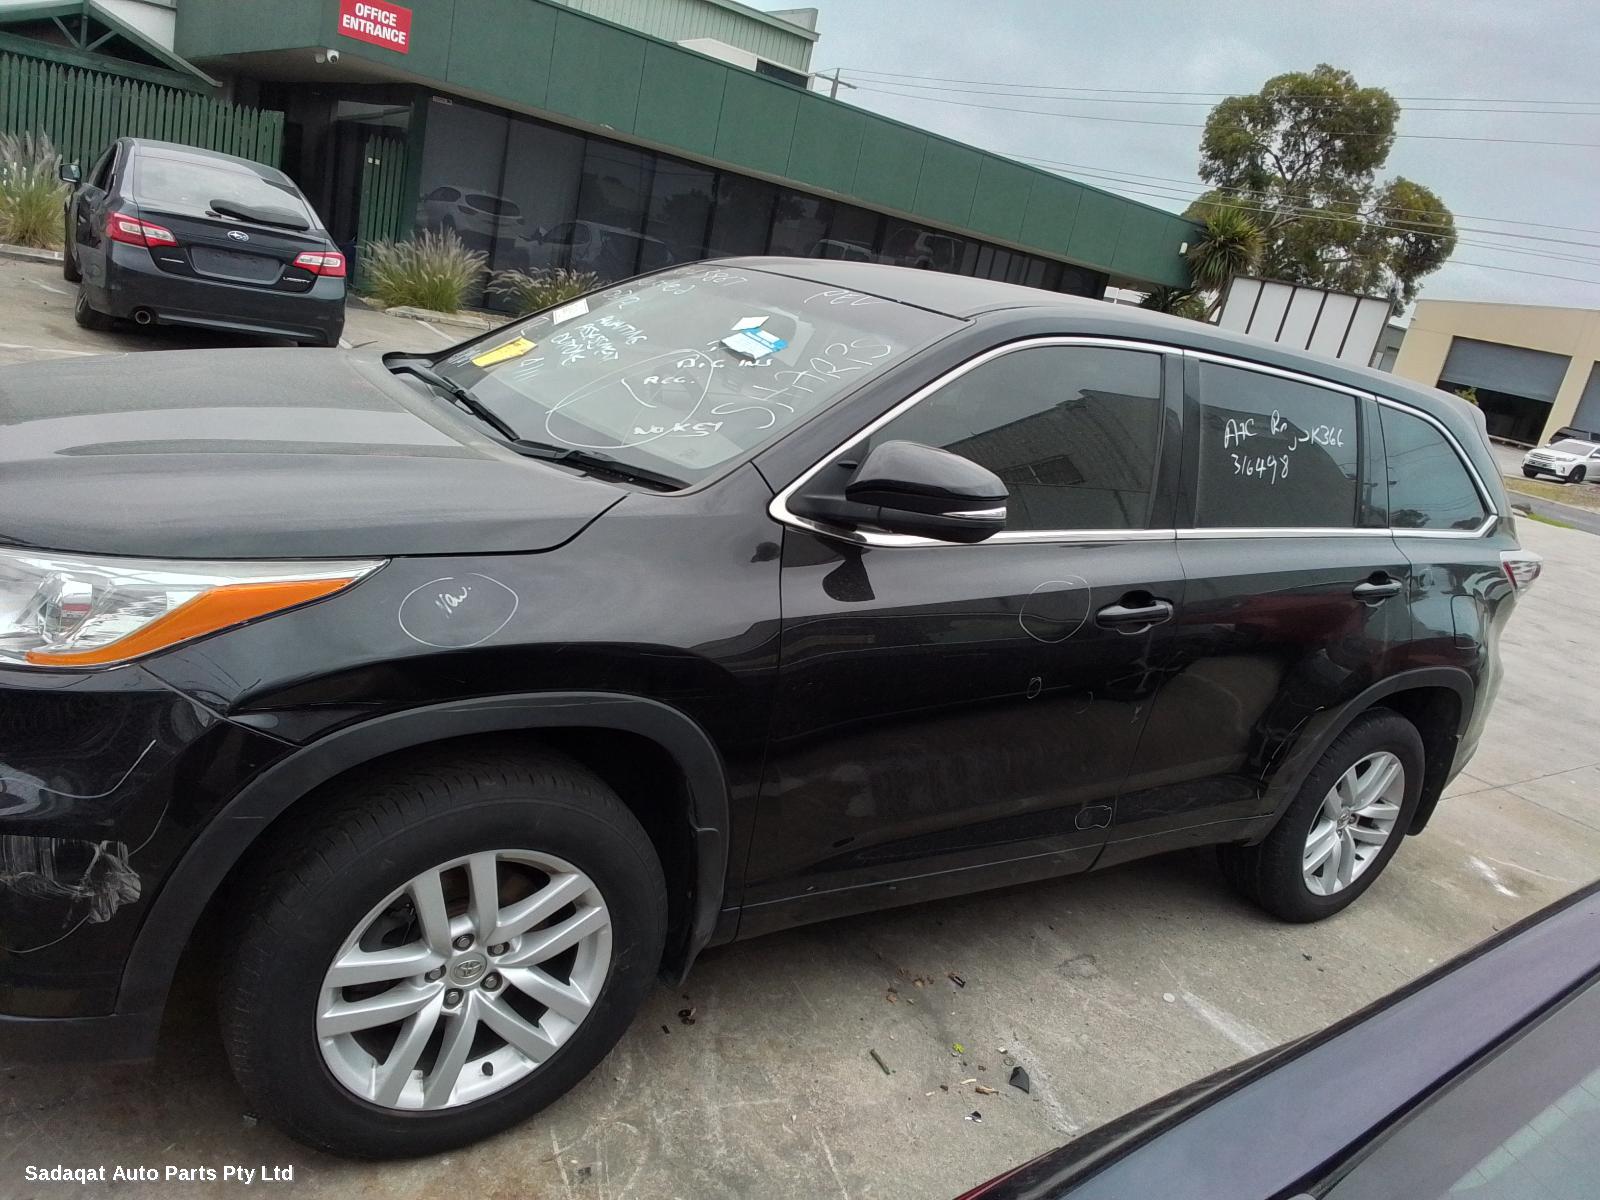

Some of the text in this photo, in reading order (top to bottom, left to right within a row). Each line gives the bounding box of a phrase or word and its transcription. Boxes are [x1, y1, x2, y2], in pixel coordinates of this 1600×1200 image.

[342, 14, 407, 45] ENTRANCE
[355, 2, 397, 27] OFFICE
[1231, 453, 1289, 485] 316498
